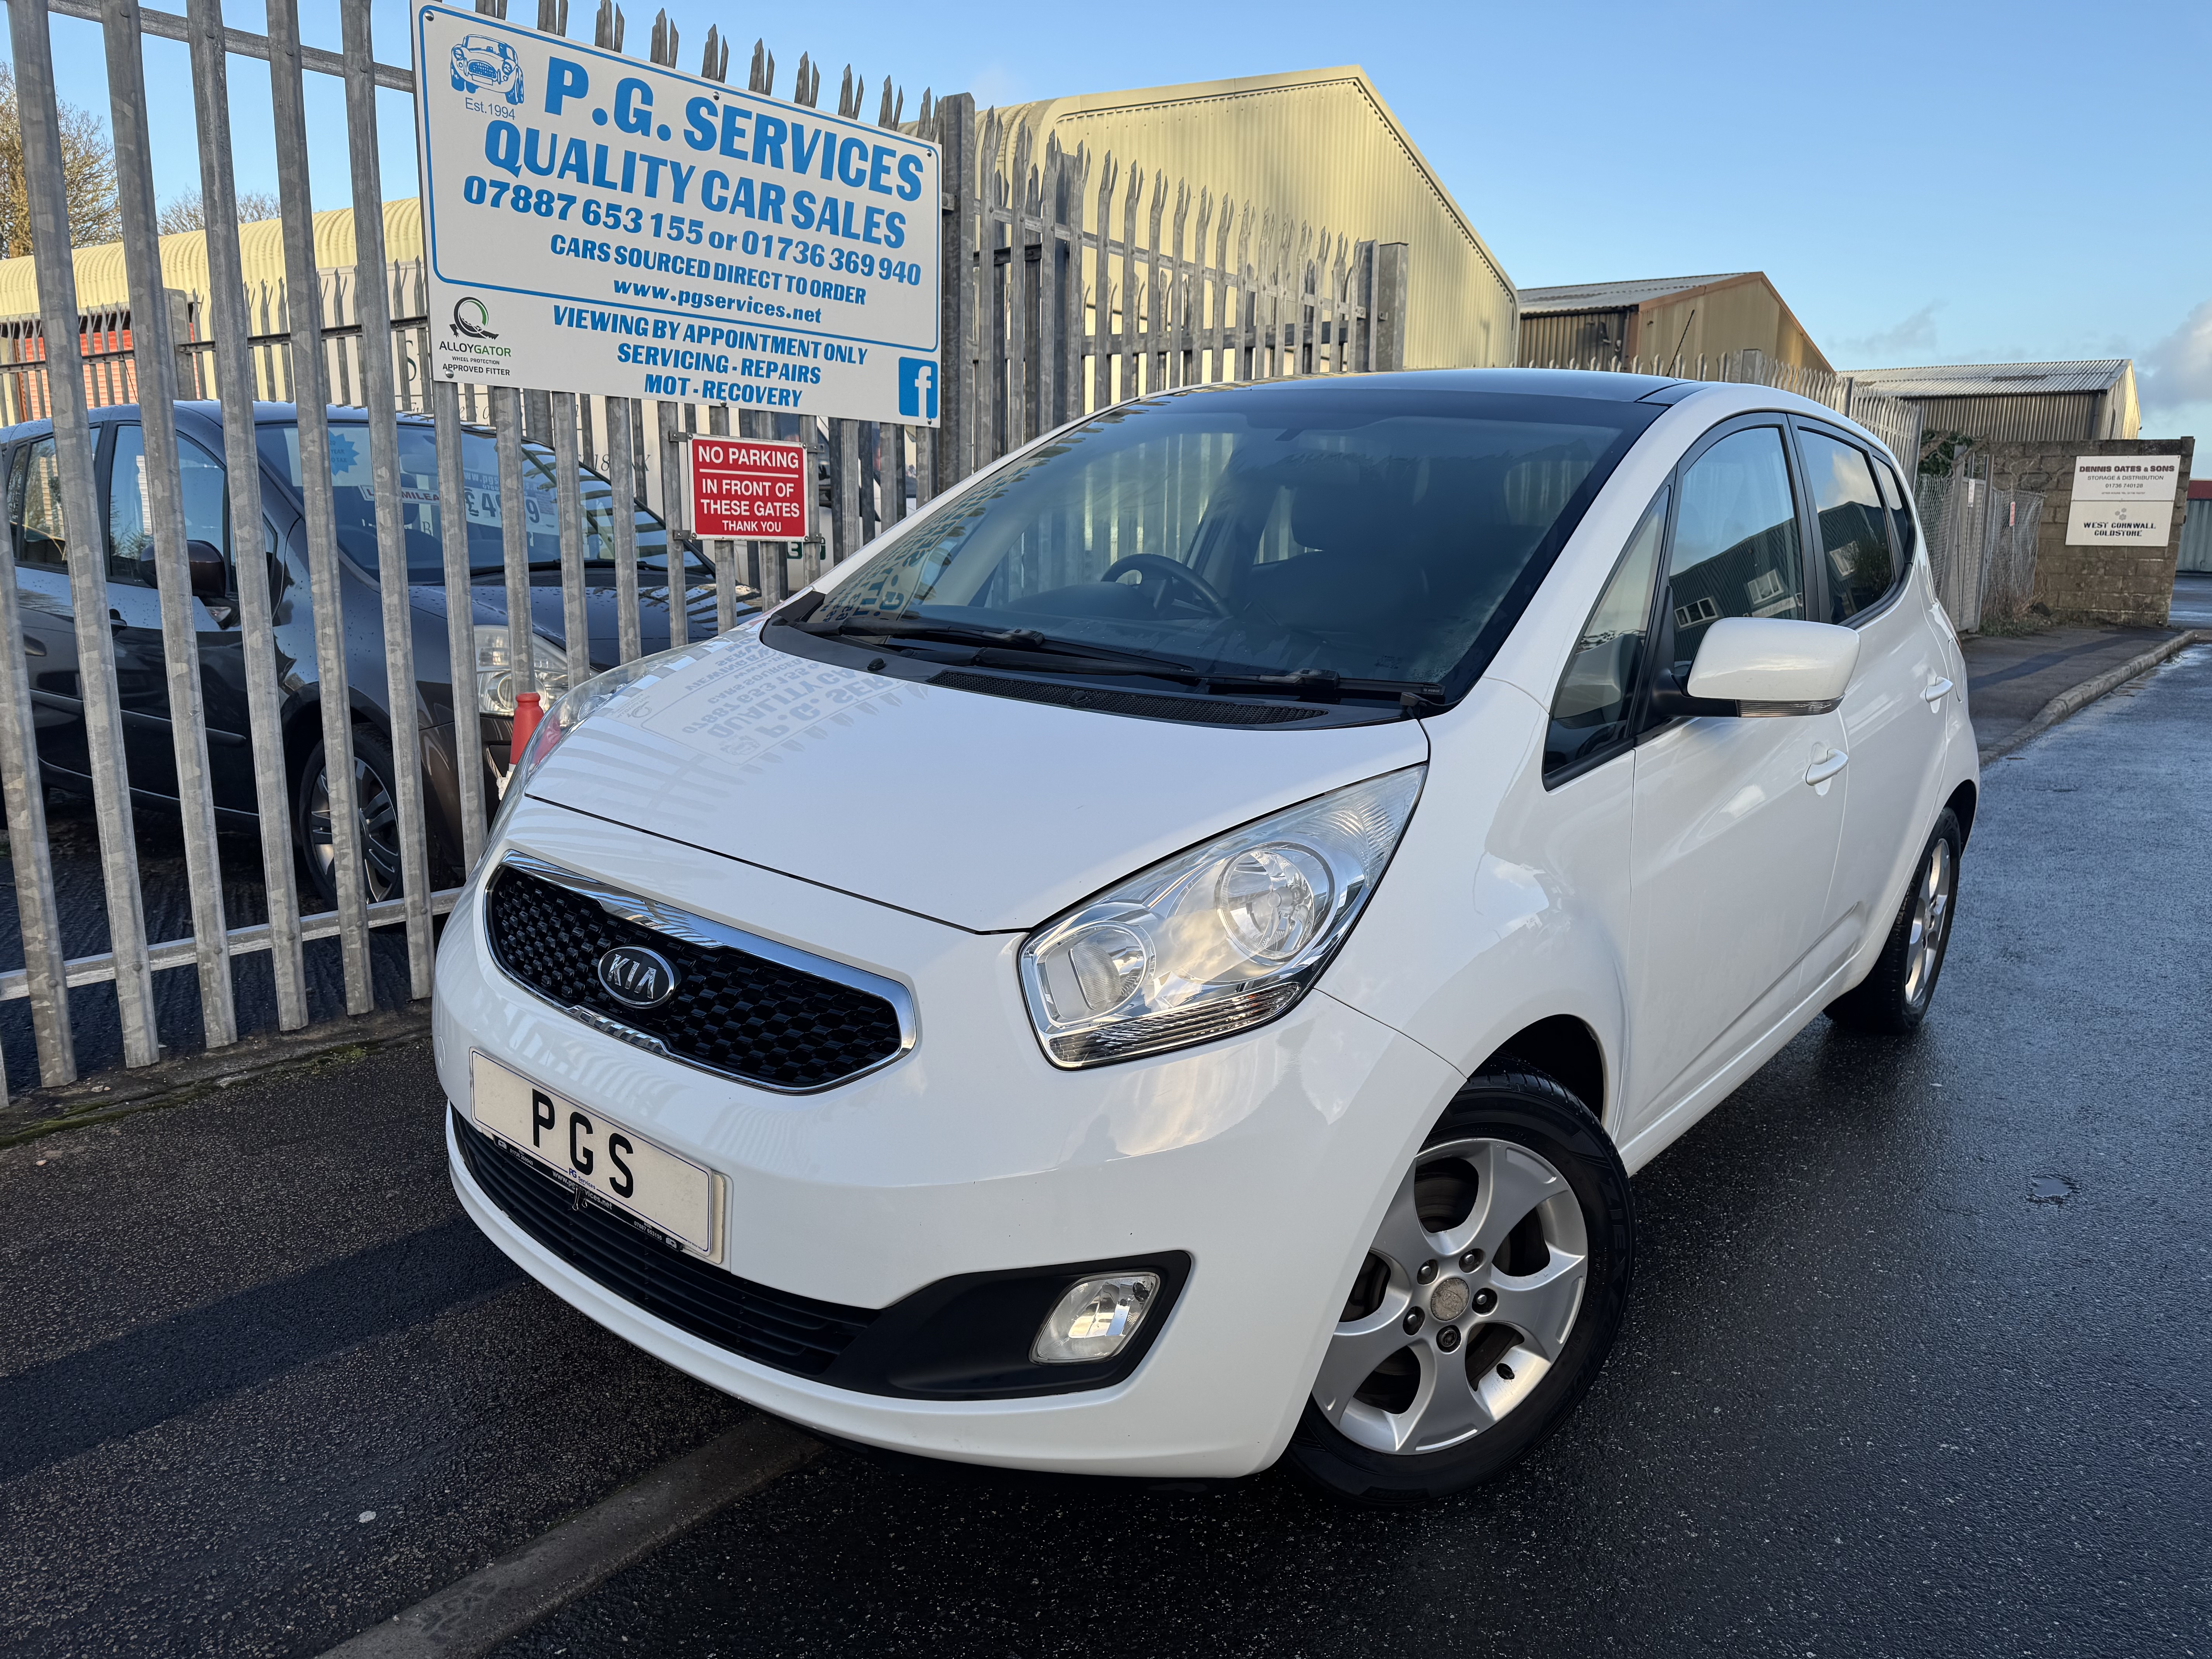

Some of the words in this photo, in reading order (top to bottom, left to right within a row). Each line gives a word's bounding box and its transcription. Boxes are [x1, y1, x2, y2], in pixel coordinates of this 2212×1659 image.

[544, 56, 671, 141] P.G.
[684, 96, 924, 201] SERVICES
[485, 120, 696, 204] QUALITY
[702, 170, 786, 225] CAR
[791, 191, 906, 249] SALES
[464, 176, 577, 221] 07887
[582, 199, 643, 234] 653
[651, 213, 704, 245] 155
[709, 231, 737, 251] or
[742, 231, 825, 268] 01736
[829, 248, 875, 277] 369
[879, 258, 921, 286] 940
[551, 234, 611, 262] CARS
[615, 246, 711, 279] SOURCED
[714, 263, 783, 290] DIRECT
[786, 275, 807, 295] TO
[810, 280, 866, 305] ORDER
[614, 280, 821, 323] www.pgservices.net
[439, 341, 511, 357] ALLOYGATOR
[554, 305, 649, 337] VIEWING
[653, 319, 680, 340] BY
[684, 324, 822, 359] APPOINTMENT
[824, 343, 867, 365] ONLY
[443, 363, 483, 373] APPROVED
[486, 368, 510, 376] FITTER
[618, 343, 729, 374] SERVICING
[741, 358, 821, 384] REPAIRS
[645, 374, 690, 396] MOT
[702, 380, 802, 407] RECOVERY
[698, 445, 723, 464] NO
[729, 448, 799, 469] PARKING
[702, 478, 717, 494] IN
[722, 479, 771, 496] FRONT
[775, 482, 794, 497] OF
[700, 499, 750, 516] THESE
[754, 501, 800, 517] GATES
[722, 520, 758, 532] THANK
[760, 521, 781, 532] YOU
[606, 953, 656, 999] KIA
[569, 1167, 577, 1178] PG
[578, 1176, 596, 1190] Services
[647, 1228, 662, 1240] 653155
